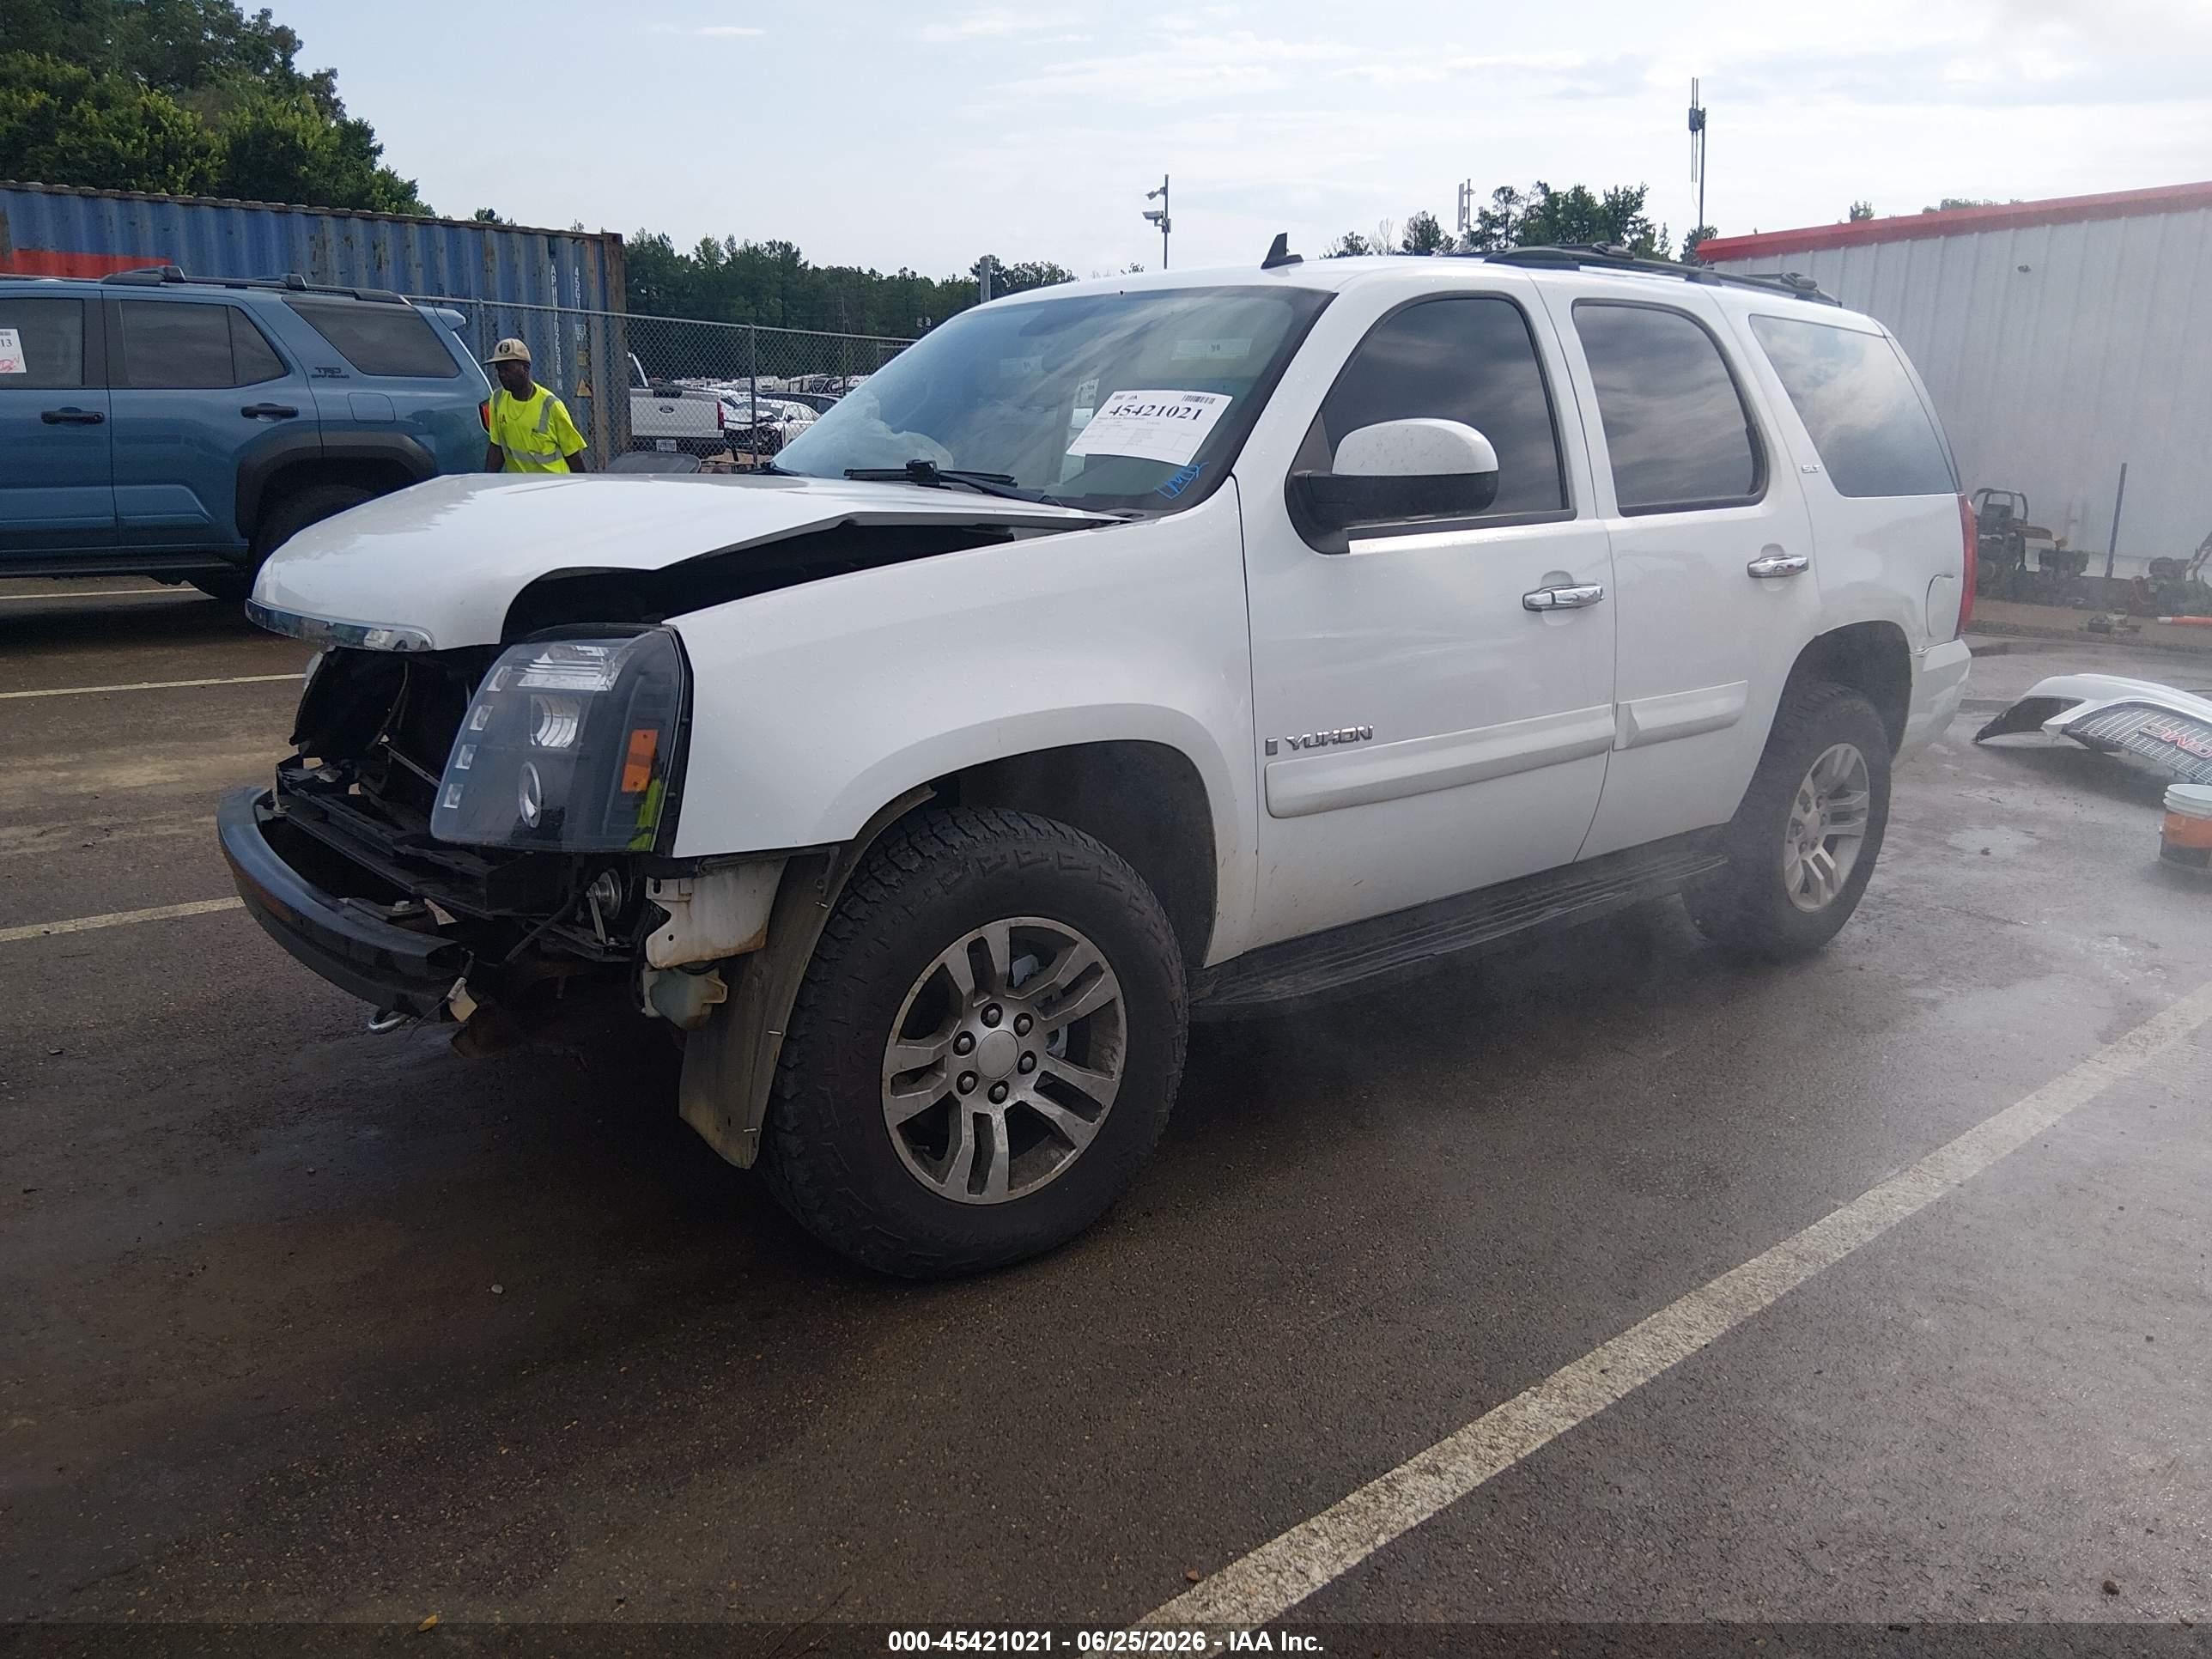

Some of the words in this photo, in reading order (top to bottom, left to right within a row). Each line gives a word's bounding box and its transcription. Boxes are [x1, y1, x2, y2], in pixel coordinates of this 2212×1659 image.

[1109, 404, 1203, 421] 45421021
[1285, 726, 1373, 750] YUKON
[2140, 722, 2212, 759] GMC
